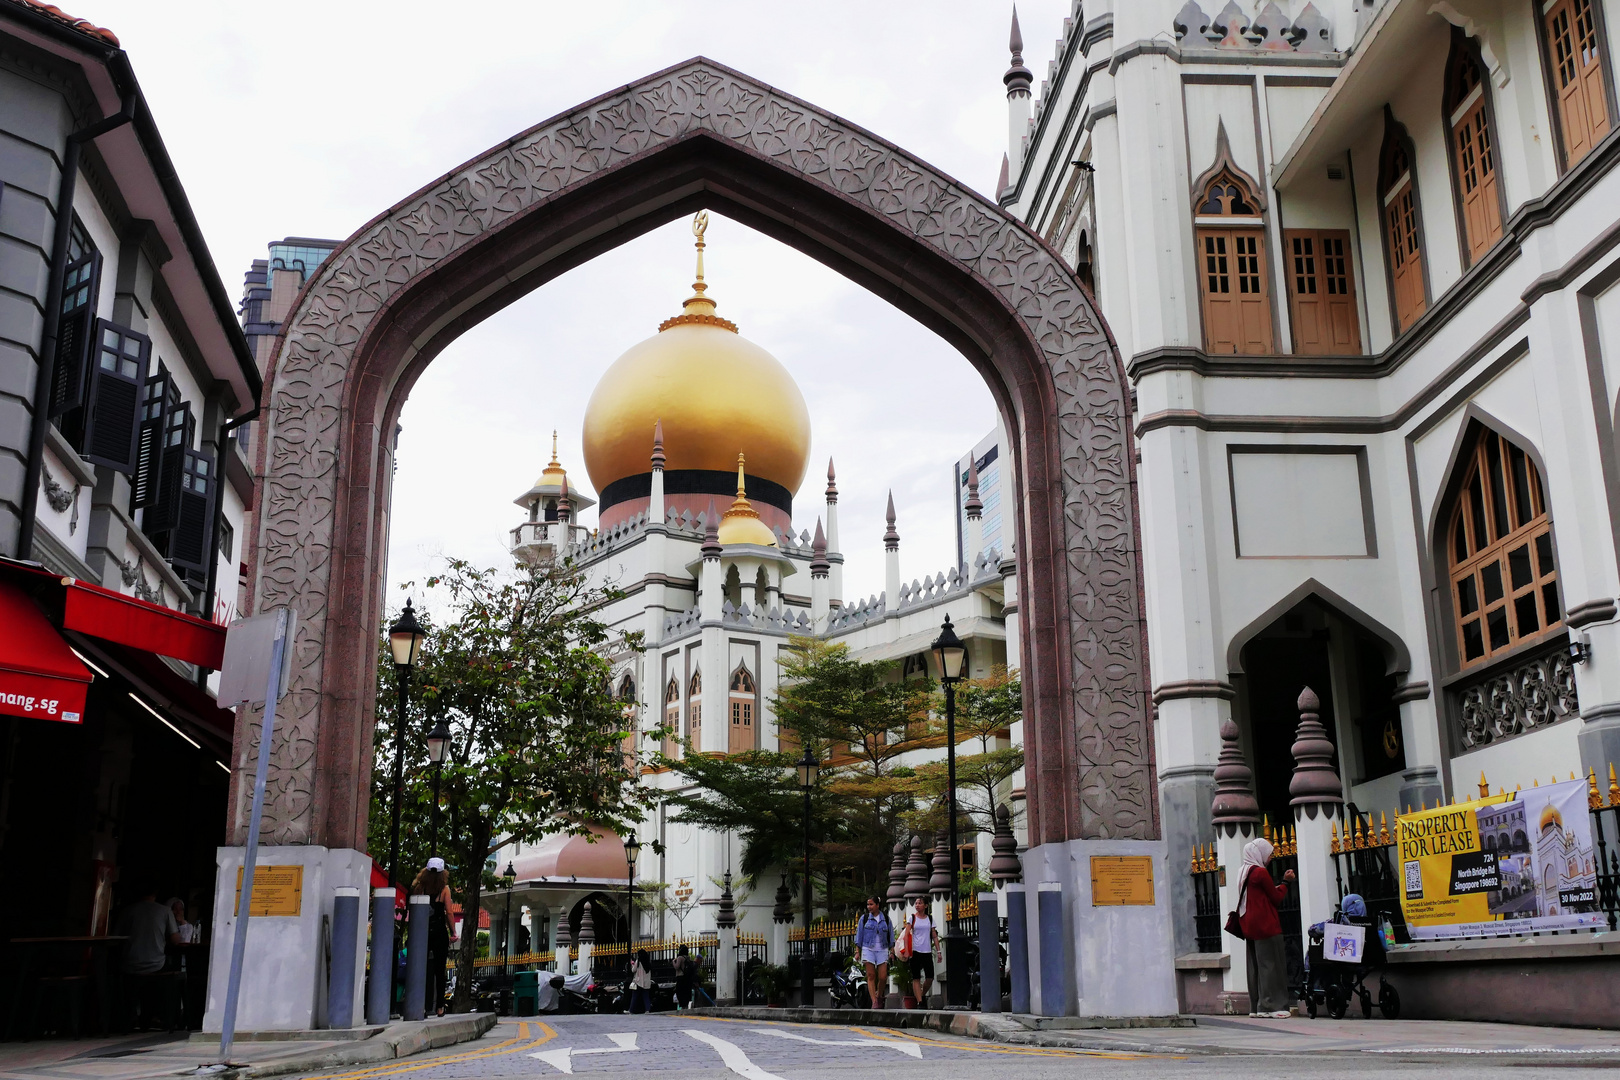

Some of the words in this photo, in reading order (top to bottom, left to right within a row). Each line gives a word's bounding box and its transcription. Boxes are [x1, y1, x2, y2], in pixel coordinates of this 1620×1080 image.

[1402, 811, 1467, 840] PROPERTY
[1402, 838, 1430, 859] FOR
[1432, 831, 1474, 855] LEASE
[1484, 854, 1494, 863] 724
[1458, 868, 1471, 878] North
[1472, 866, 1488, 877] Bridge
[1488, 865, 1495, 874] Rd
[1455, 880, 1480, 891] Singapore
[1480, 878, 1498, 887] 198692
[1562, 894, 1568, 903] 30
[1569, 894, 1579, 902] Nov
[1580, 892, 1593, 901] 2022
